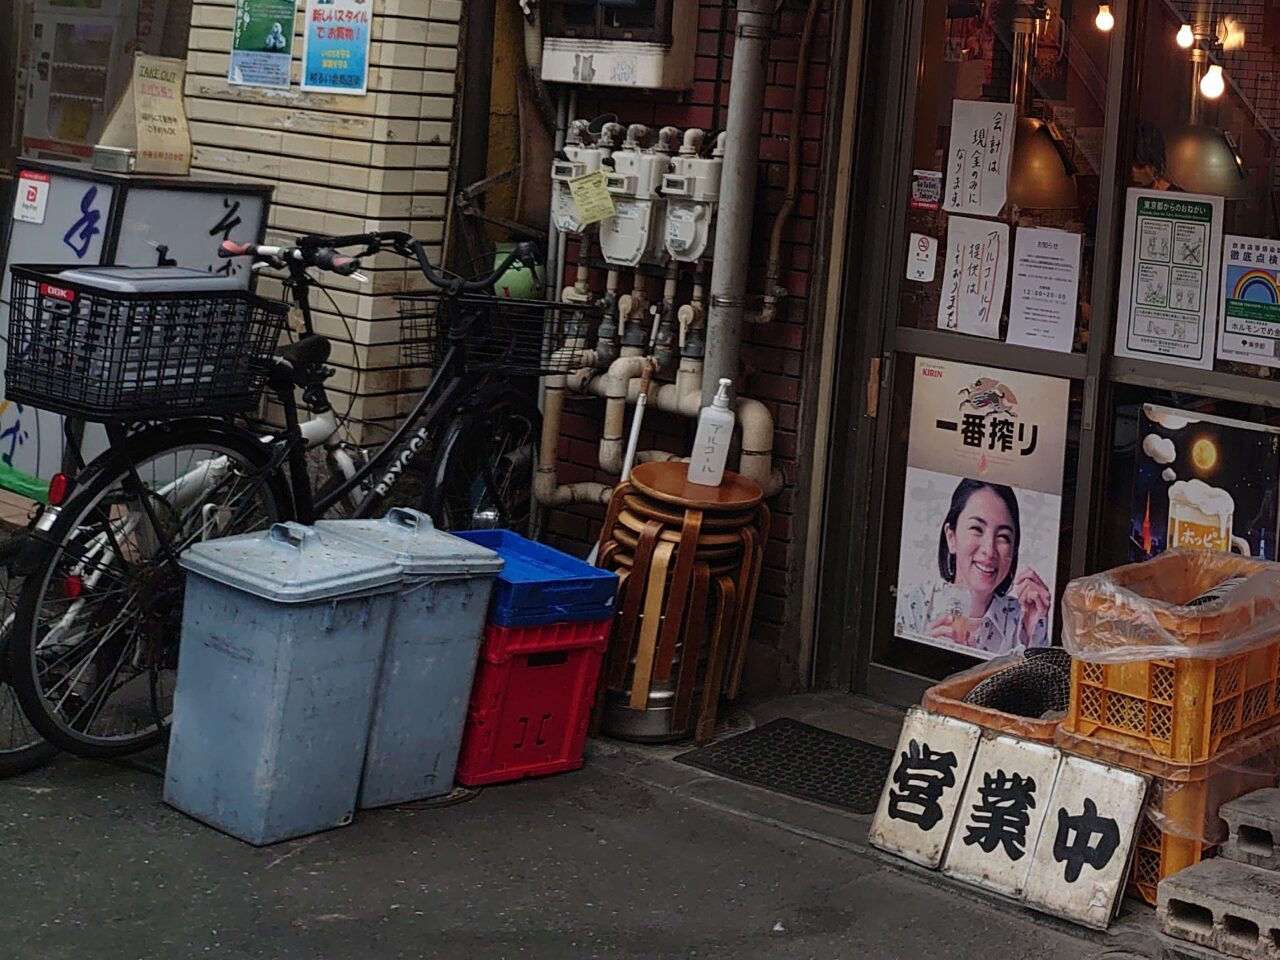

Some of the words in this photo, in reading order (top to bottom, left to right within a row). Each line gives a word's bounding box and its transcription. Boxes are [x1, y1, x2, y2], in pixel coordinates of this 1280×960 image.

[312, 8, 368, 23] 新しいスタイル
[969, 128, 987, 204] 現金のみに
[988, 111, 1003, 174] 会計は
[1143, 201, 1207, 215] 東京都からのおねがい
[967, 243, 982, 296] 提供は
[978, 231, 999, 323] アルコールの
[922, 367, 943, 379] KIRIN
[936, 413, 1039, 456] 一番搾り
[1180, 523, 1222, 547] ホッピー
[887, 738, 1121, 883] 営業中
